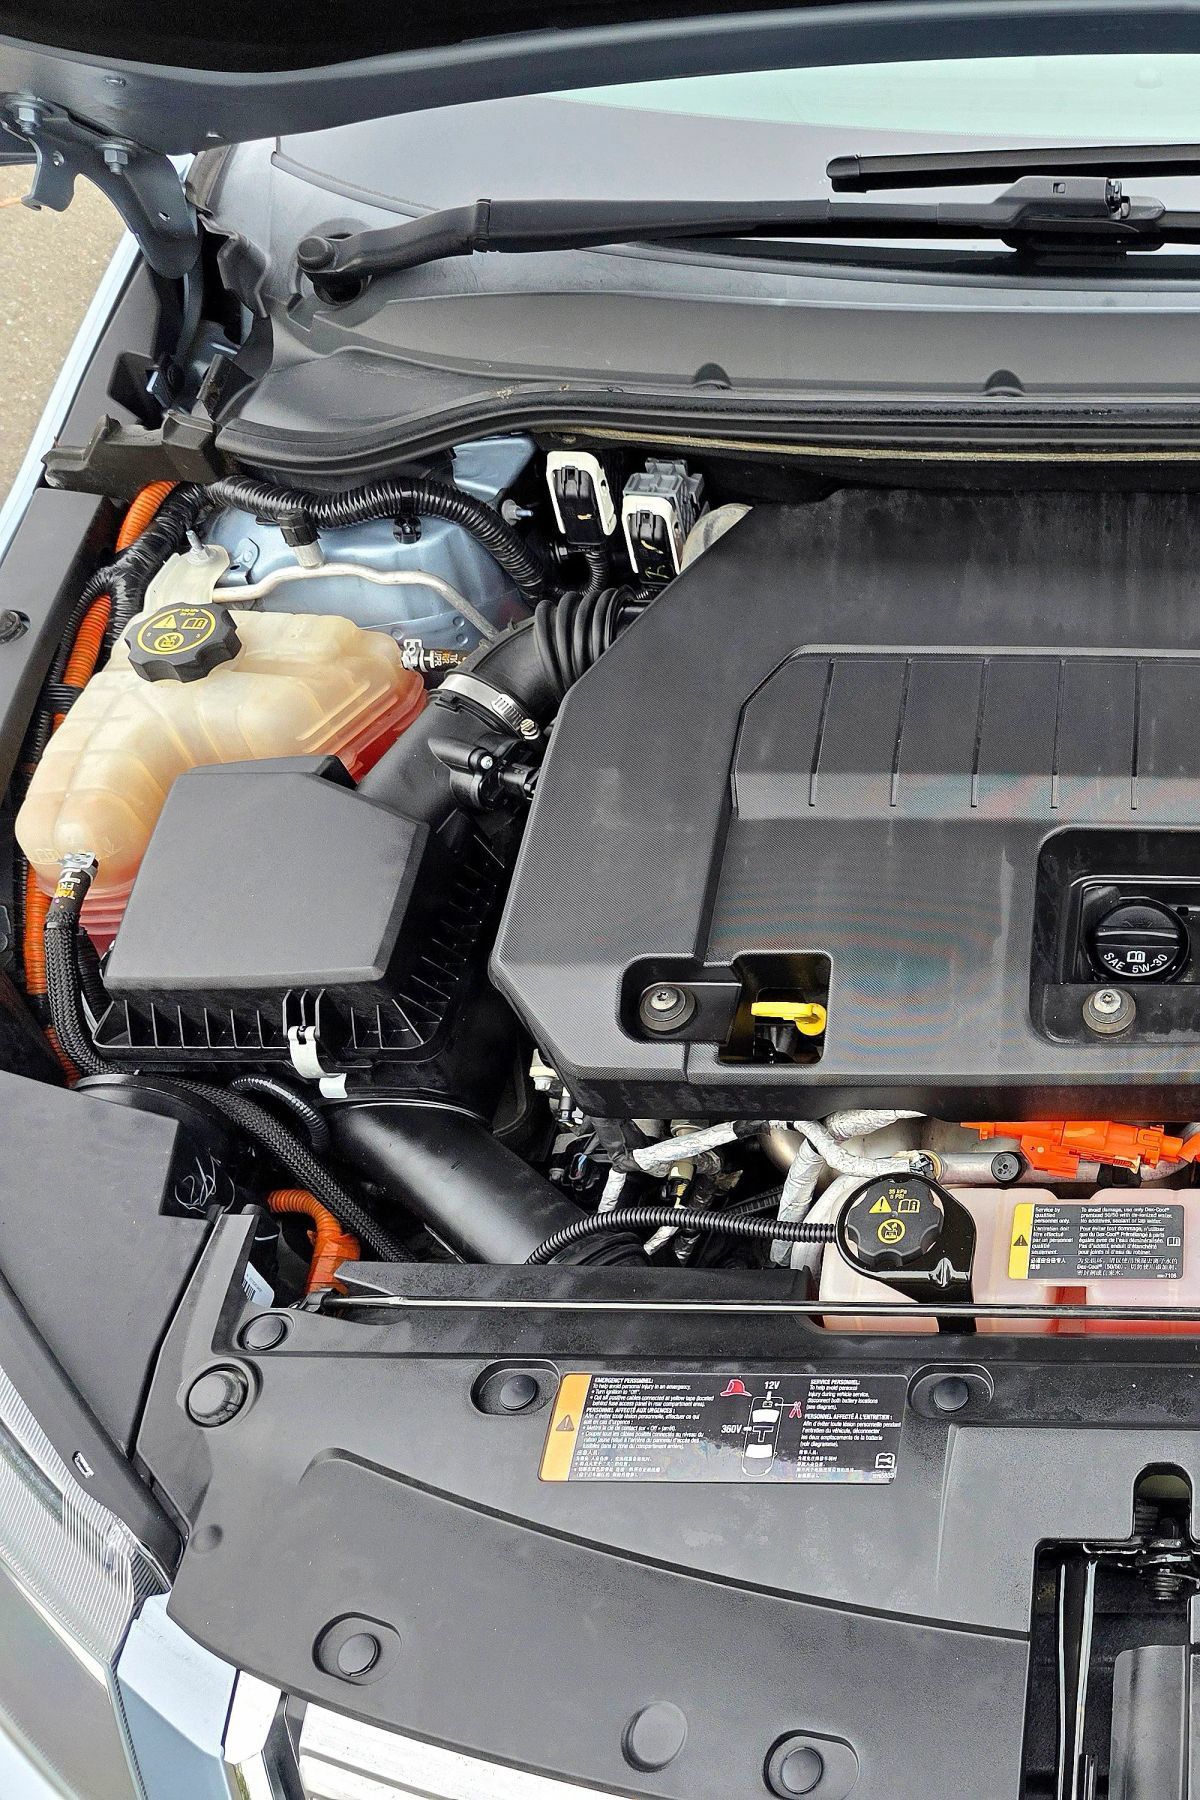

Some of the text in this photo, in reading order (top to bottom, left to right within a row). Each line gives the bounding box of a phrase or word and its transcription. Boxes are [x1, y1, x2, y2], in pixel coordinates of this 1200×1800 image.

[1103, 952, 1168, 974] SAE 5W-30
[764, 1381, 780, 1390] 12V
[721, 1424, 742, 1434] 360V
